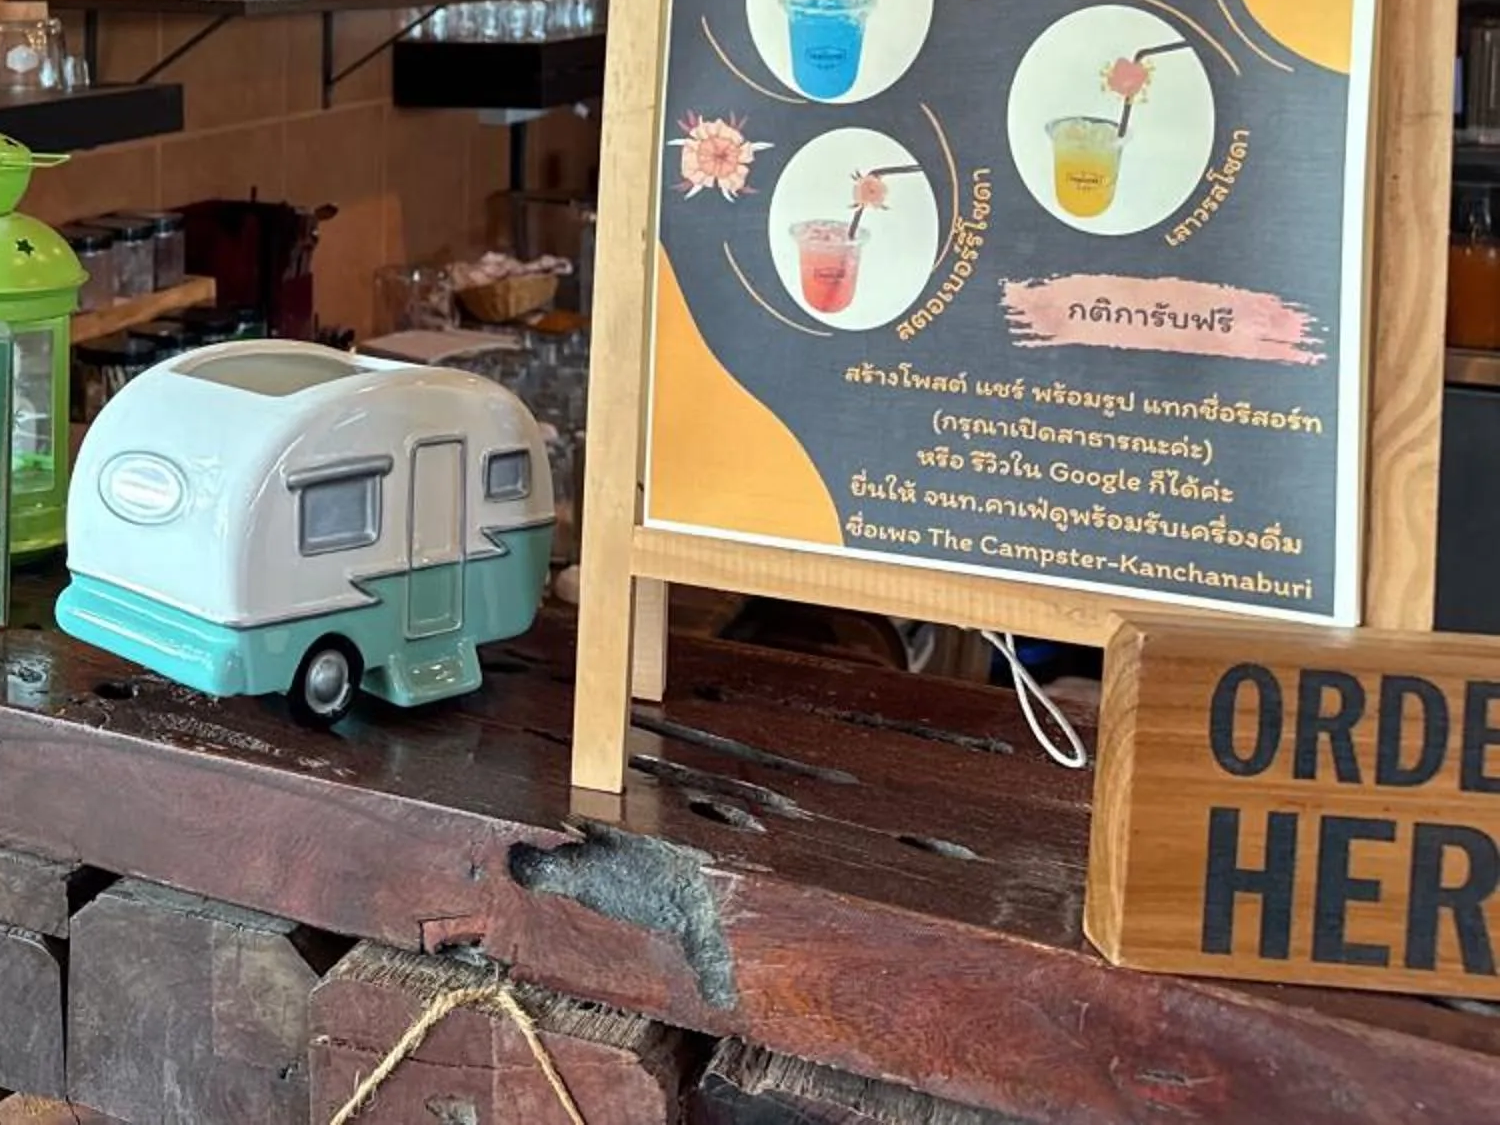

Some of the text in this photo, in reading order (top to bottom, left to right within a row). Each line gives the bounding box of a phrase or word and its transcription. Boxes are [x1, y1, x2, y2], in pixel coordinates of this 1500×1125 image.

[1068, 296, 1235, 334] กติการับฟรี
[845, 363, 968, 394] สร้างโพสต์
[975, 378, 1026, 400] แชร์
[1032, 381, 1135, 418] พร้อมรูป
[1049, 462, 1141, 494] Google
[927, 527, 973, 552] The
[980, 535, 1313, 600] Campster-Kanchanaburi
